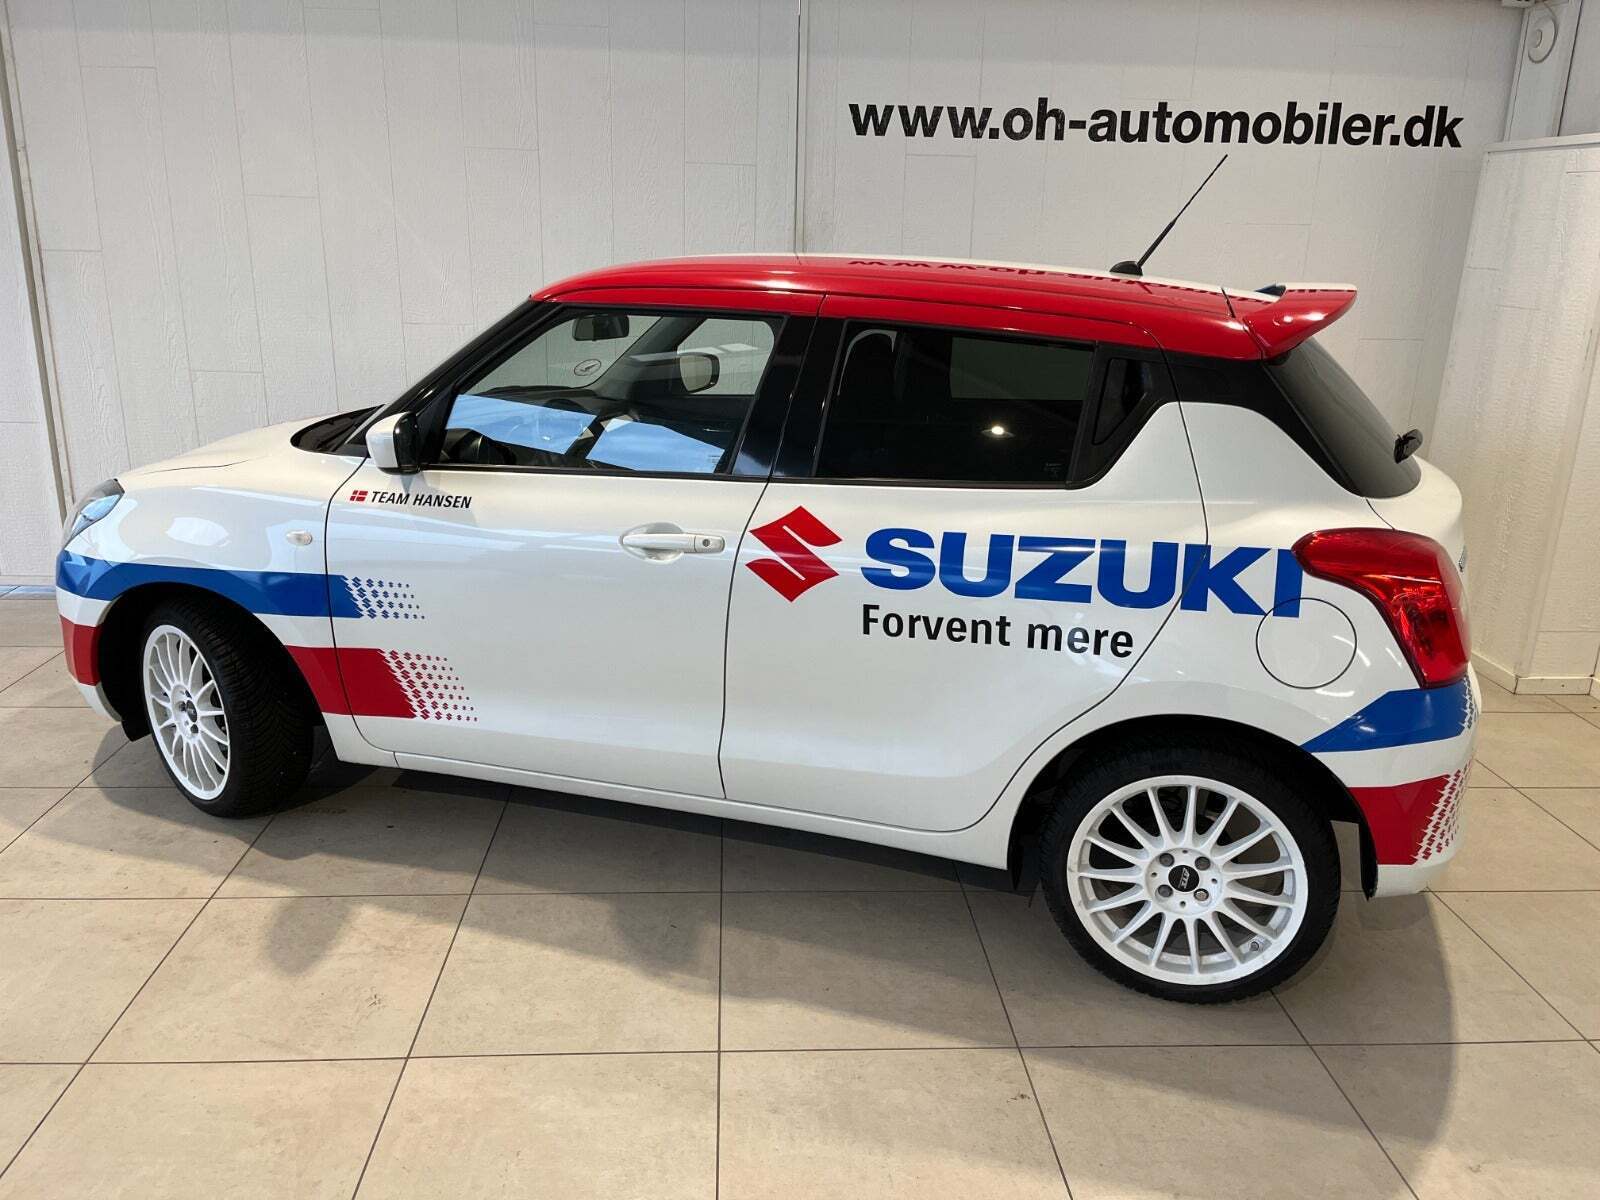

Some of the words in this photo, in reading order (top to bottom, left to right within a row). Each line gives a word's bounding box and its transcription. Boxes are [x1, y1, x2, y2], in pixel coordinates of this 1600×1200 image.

[848, 97, 1465, 148] www.oh-automobiler.dk
[371, 490, 411, 505] TEAM
[412, 493, 473, 509] HANSEN
[860, 527, 1303, 618] SUZUKI
[862, 603, 1011, 647] Forvent
[1026, 620, 1134, 659] mere
